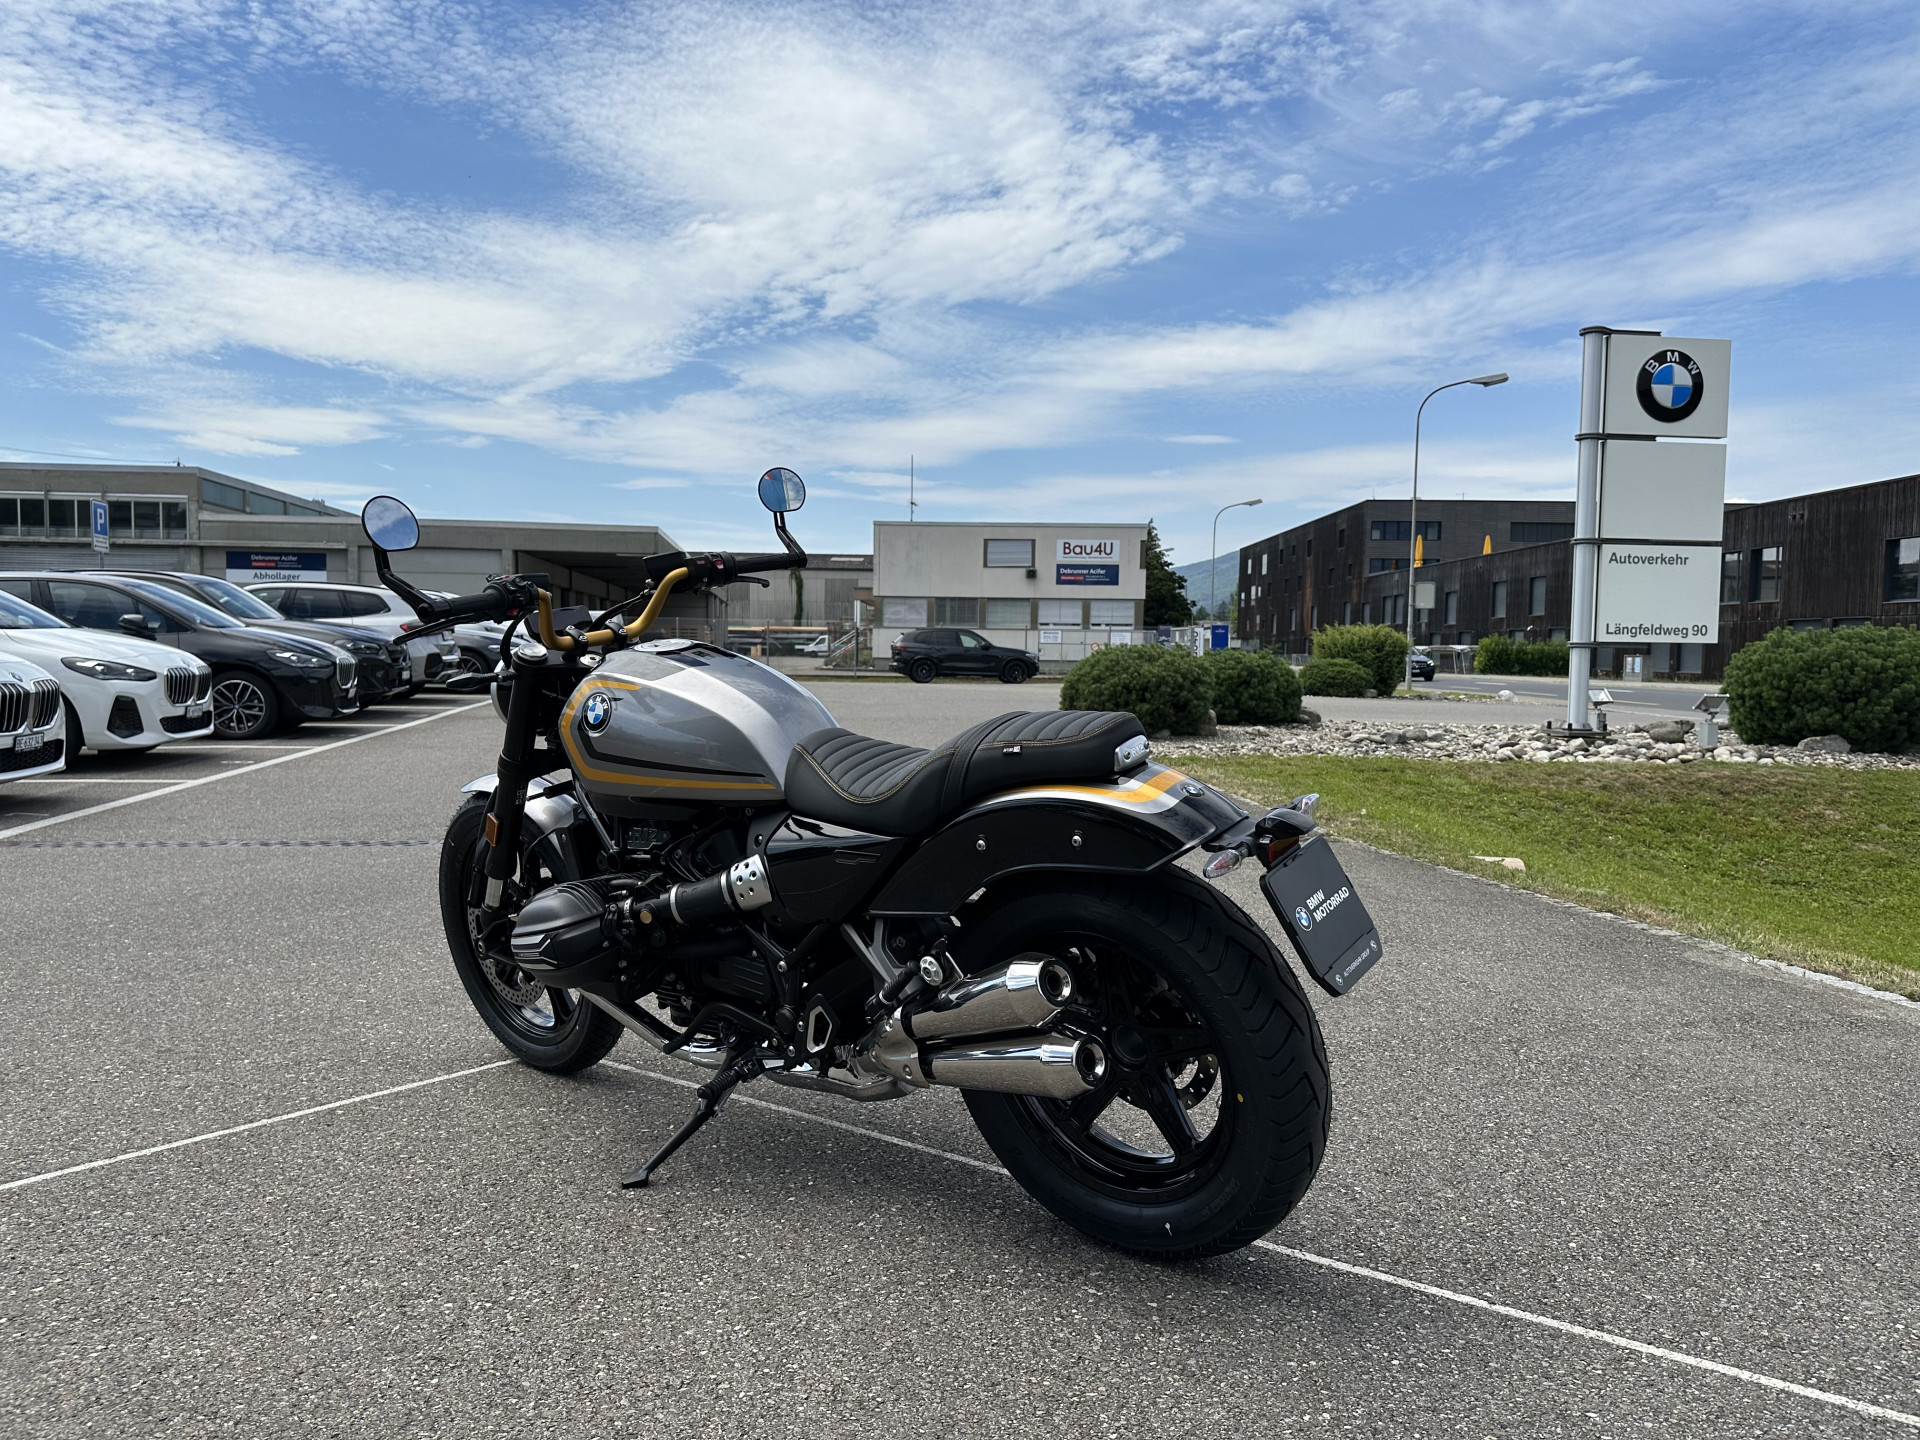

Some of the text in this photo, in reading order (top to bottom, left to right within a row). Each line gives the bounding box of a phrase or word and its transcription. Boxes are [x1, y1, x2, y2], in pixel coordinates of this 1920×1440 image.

[1645, 351, 1700, 375] BMW
[97, 508, 104, 531] P
[1063, 541, 1113, 556] Bau4U
[1608, 552, 1689, 566] Autoverkehr
[253, 572, 300, 581] Abhollager
[1606, 623, 1708, 639] Längfeldweg 90
[1306, 889, 1325, 910] BMW
[1313, 887, 1349, 922] MOTORRAD
